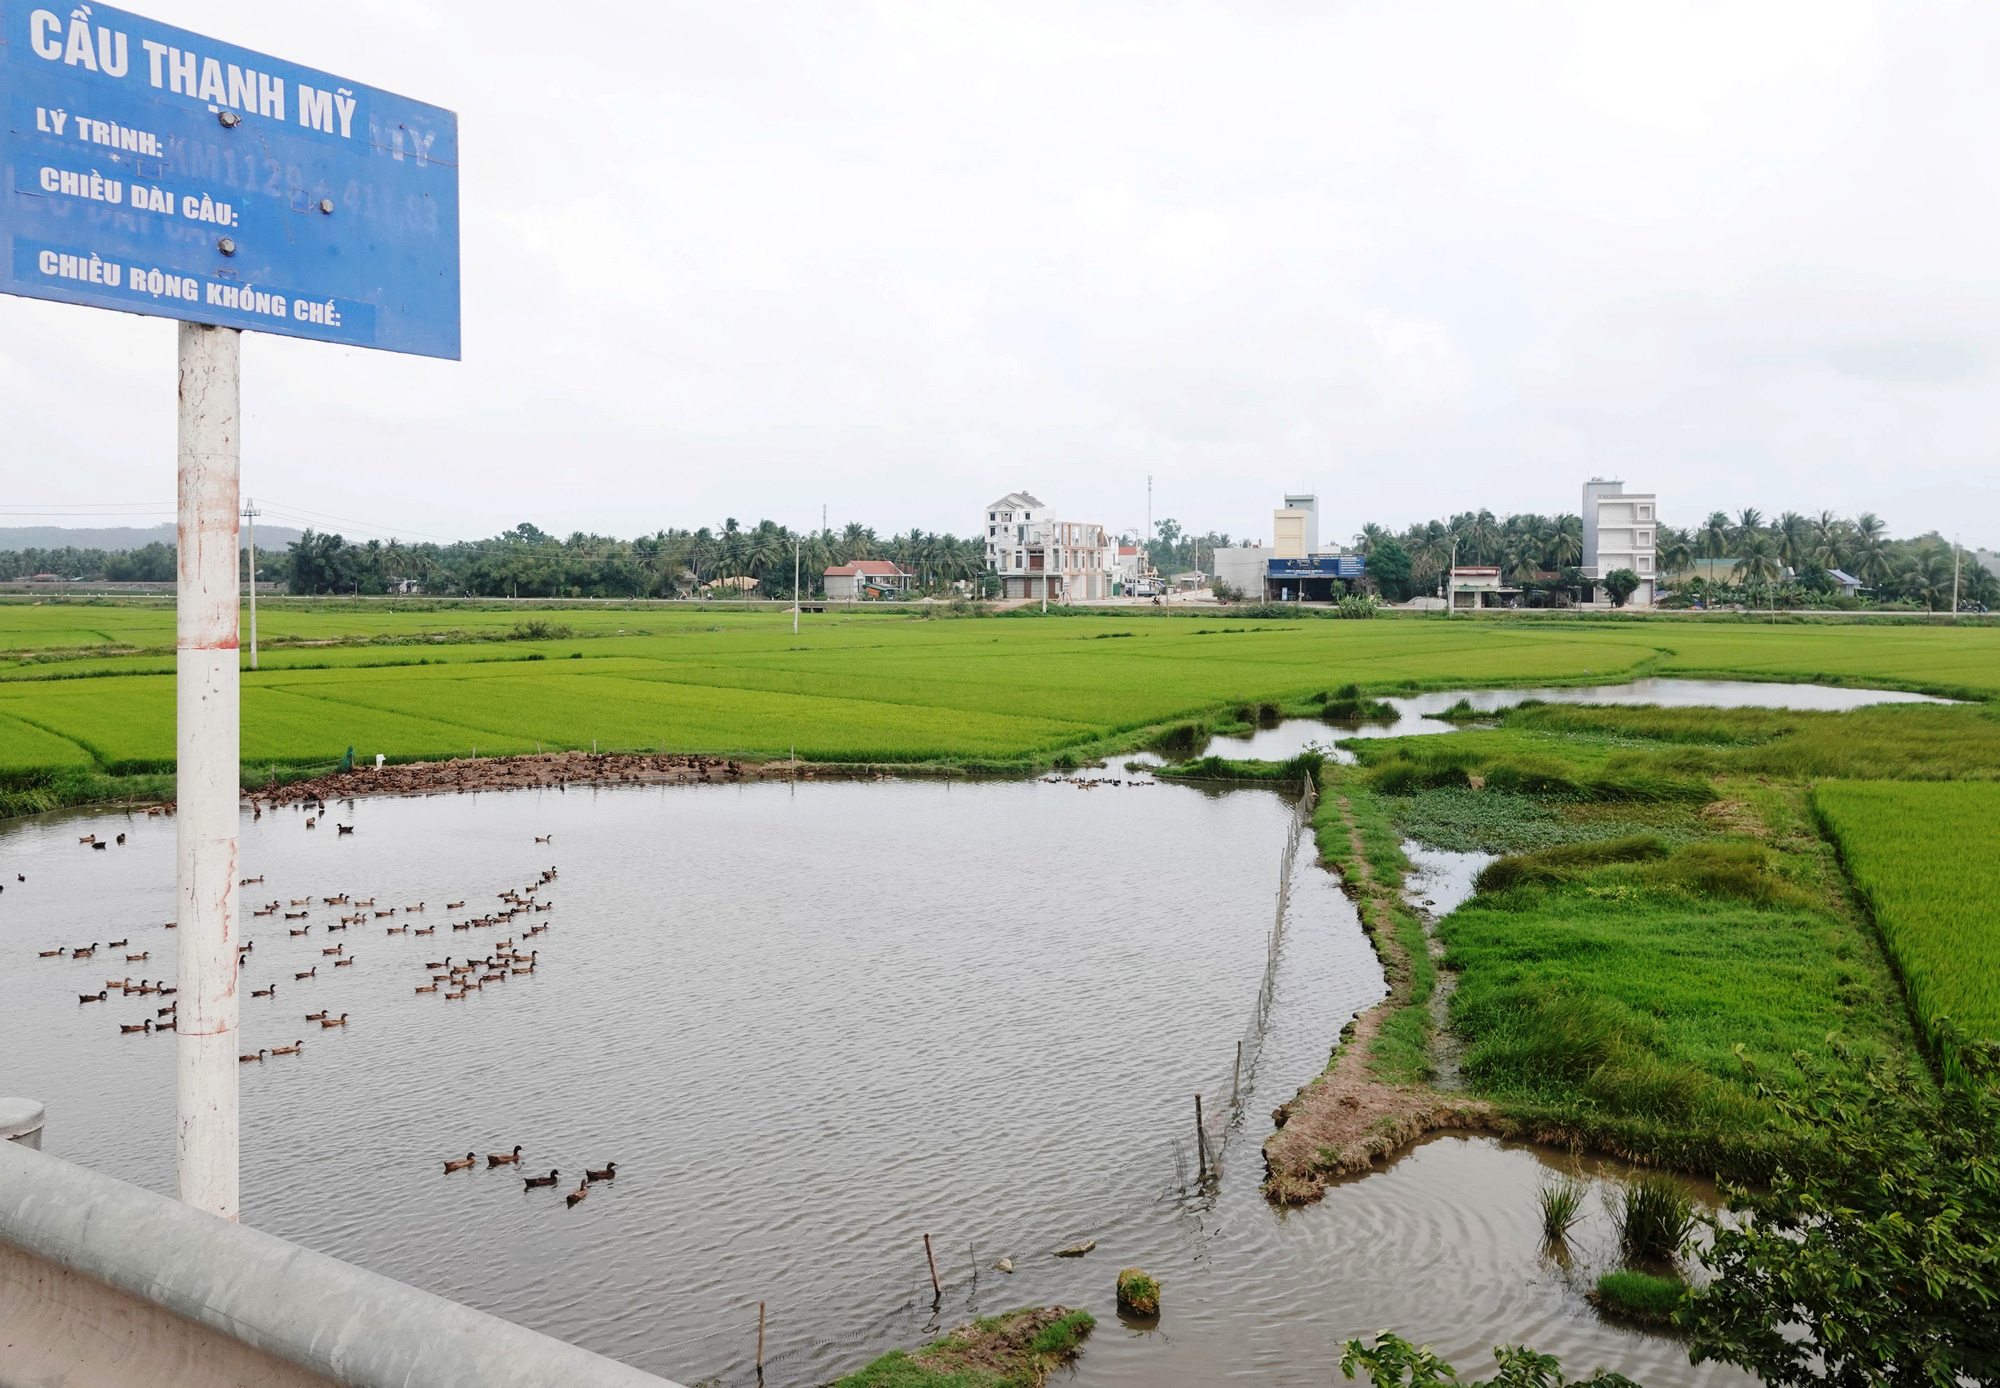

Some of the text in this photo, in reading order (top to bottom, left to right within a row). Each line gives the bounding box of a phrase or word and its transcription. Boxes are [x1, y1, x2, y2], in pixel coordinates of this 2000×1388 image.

[30, 4, 357, 139] CẦU THẠNH MỸ
[36, 107, 164, 157] LÝ TRÌNH:
[40, 167, 123, 204] CHIỀU
[131, 184, 175, 210] DÀI
[182, 192, 239, 227] CẦU:
[39, 251, 341, 327] CHIỀU RỘNG KHỐNG CHẾ:
